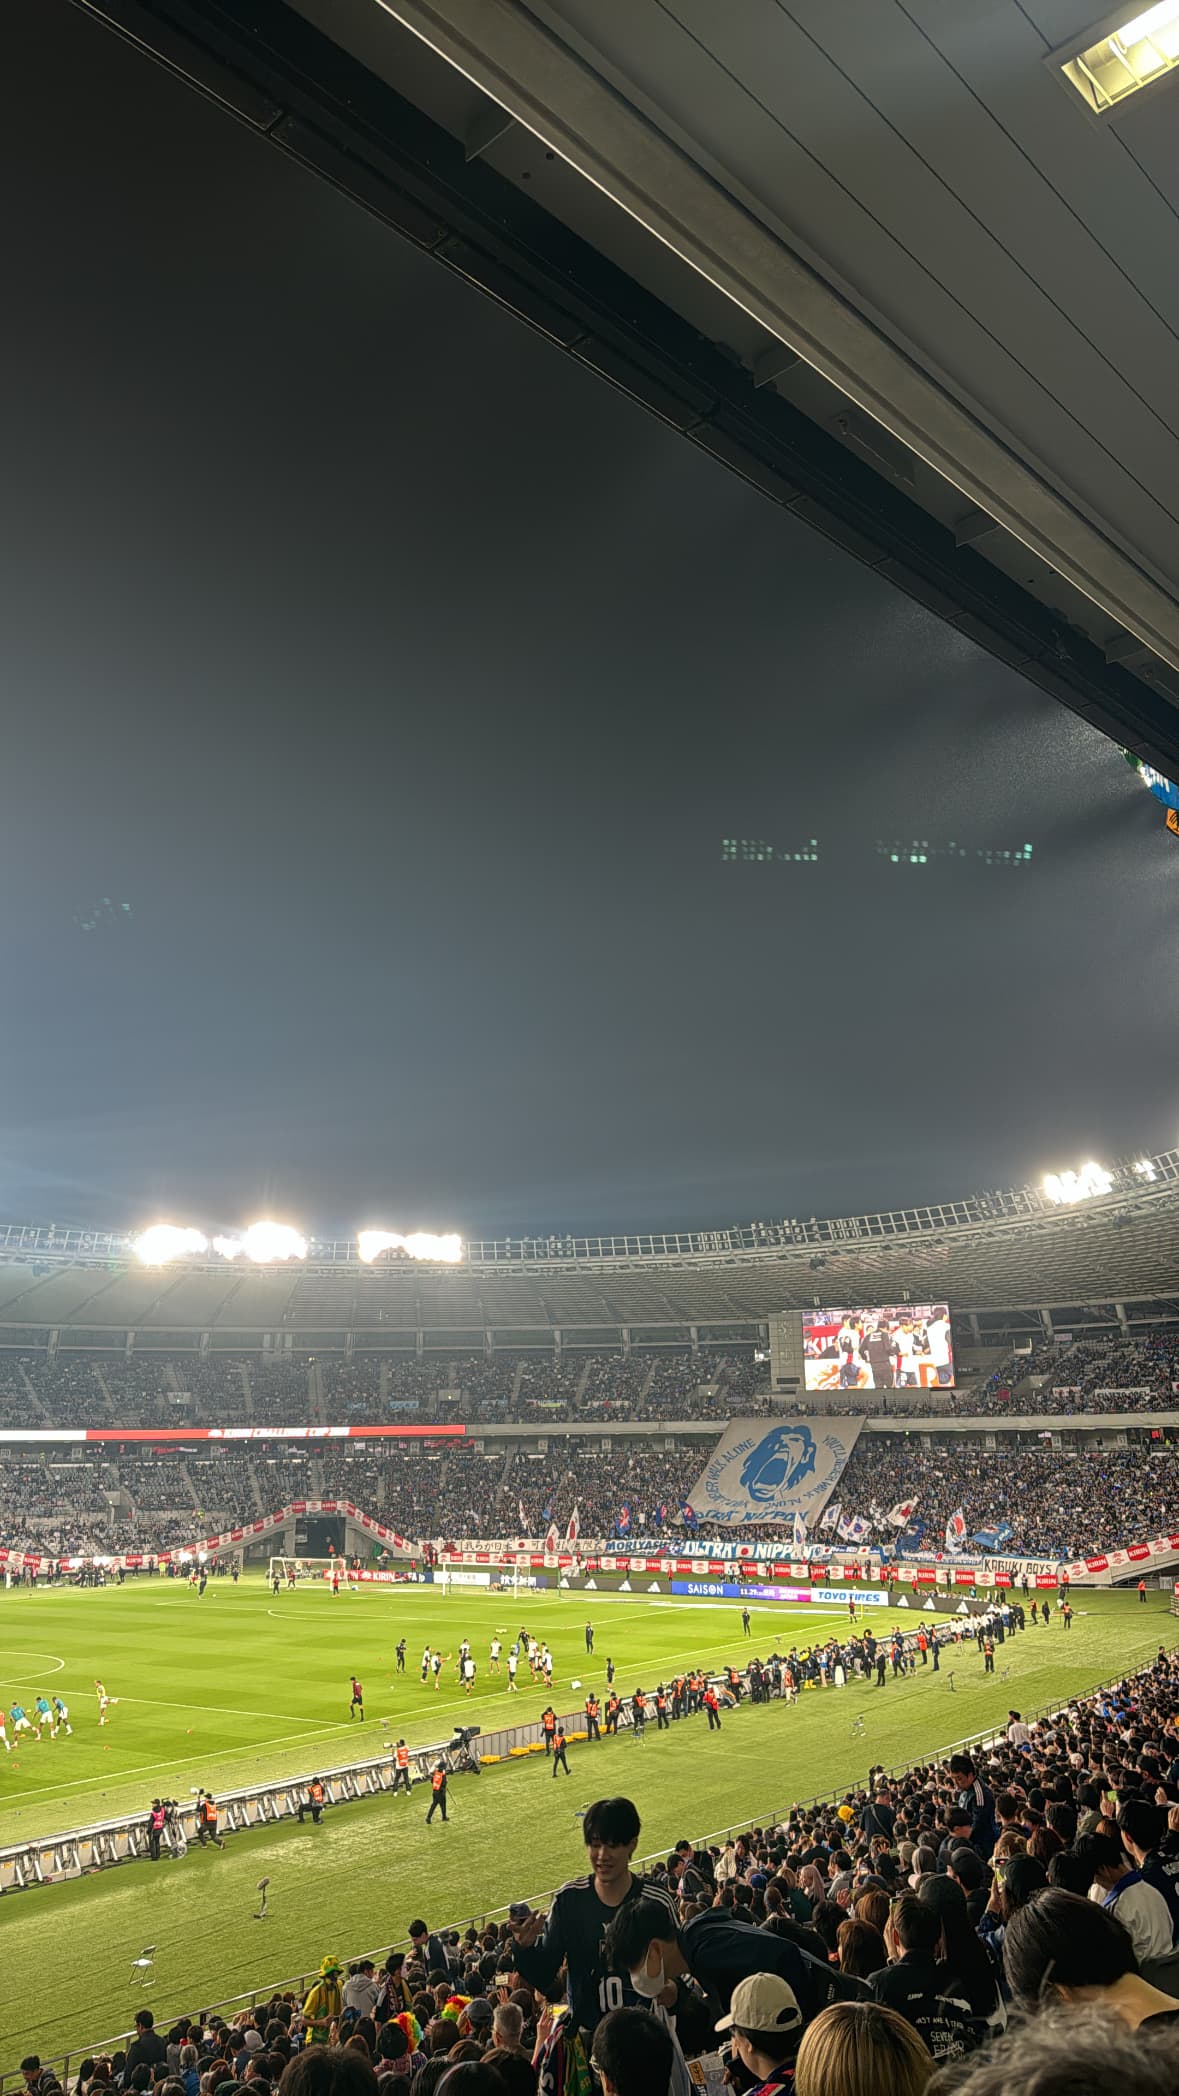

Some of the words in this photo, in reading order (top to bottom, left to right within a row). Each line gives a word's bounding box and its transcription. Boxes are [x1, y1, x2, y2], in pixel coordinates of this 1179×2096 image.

[721, 1438, 757, 1464] ALONE
[1129, 1546, 1149, 1557] KIRIN
[984, 1559, 1023, 1574] KABUKI
[1026, 1563, 1053, 1575] BOYS
[1087, 1558, 1107, 1569] KIRIN
[372, 1572, 396, 1582] KIRIN
[1036, 1576, 1057, 1585] KIRIN
[688, 1584, 724, 1595] SAISON
[818, 1591, 847, 1601] TOYO
[848, 1592, 881, 1602] TIRES
[598, 1976, 624, 2012] 10
[930, 2031, 955, 2042] SEVEN
